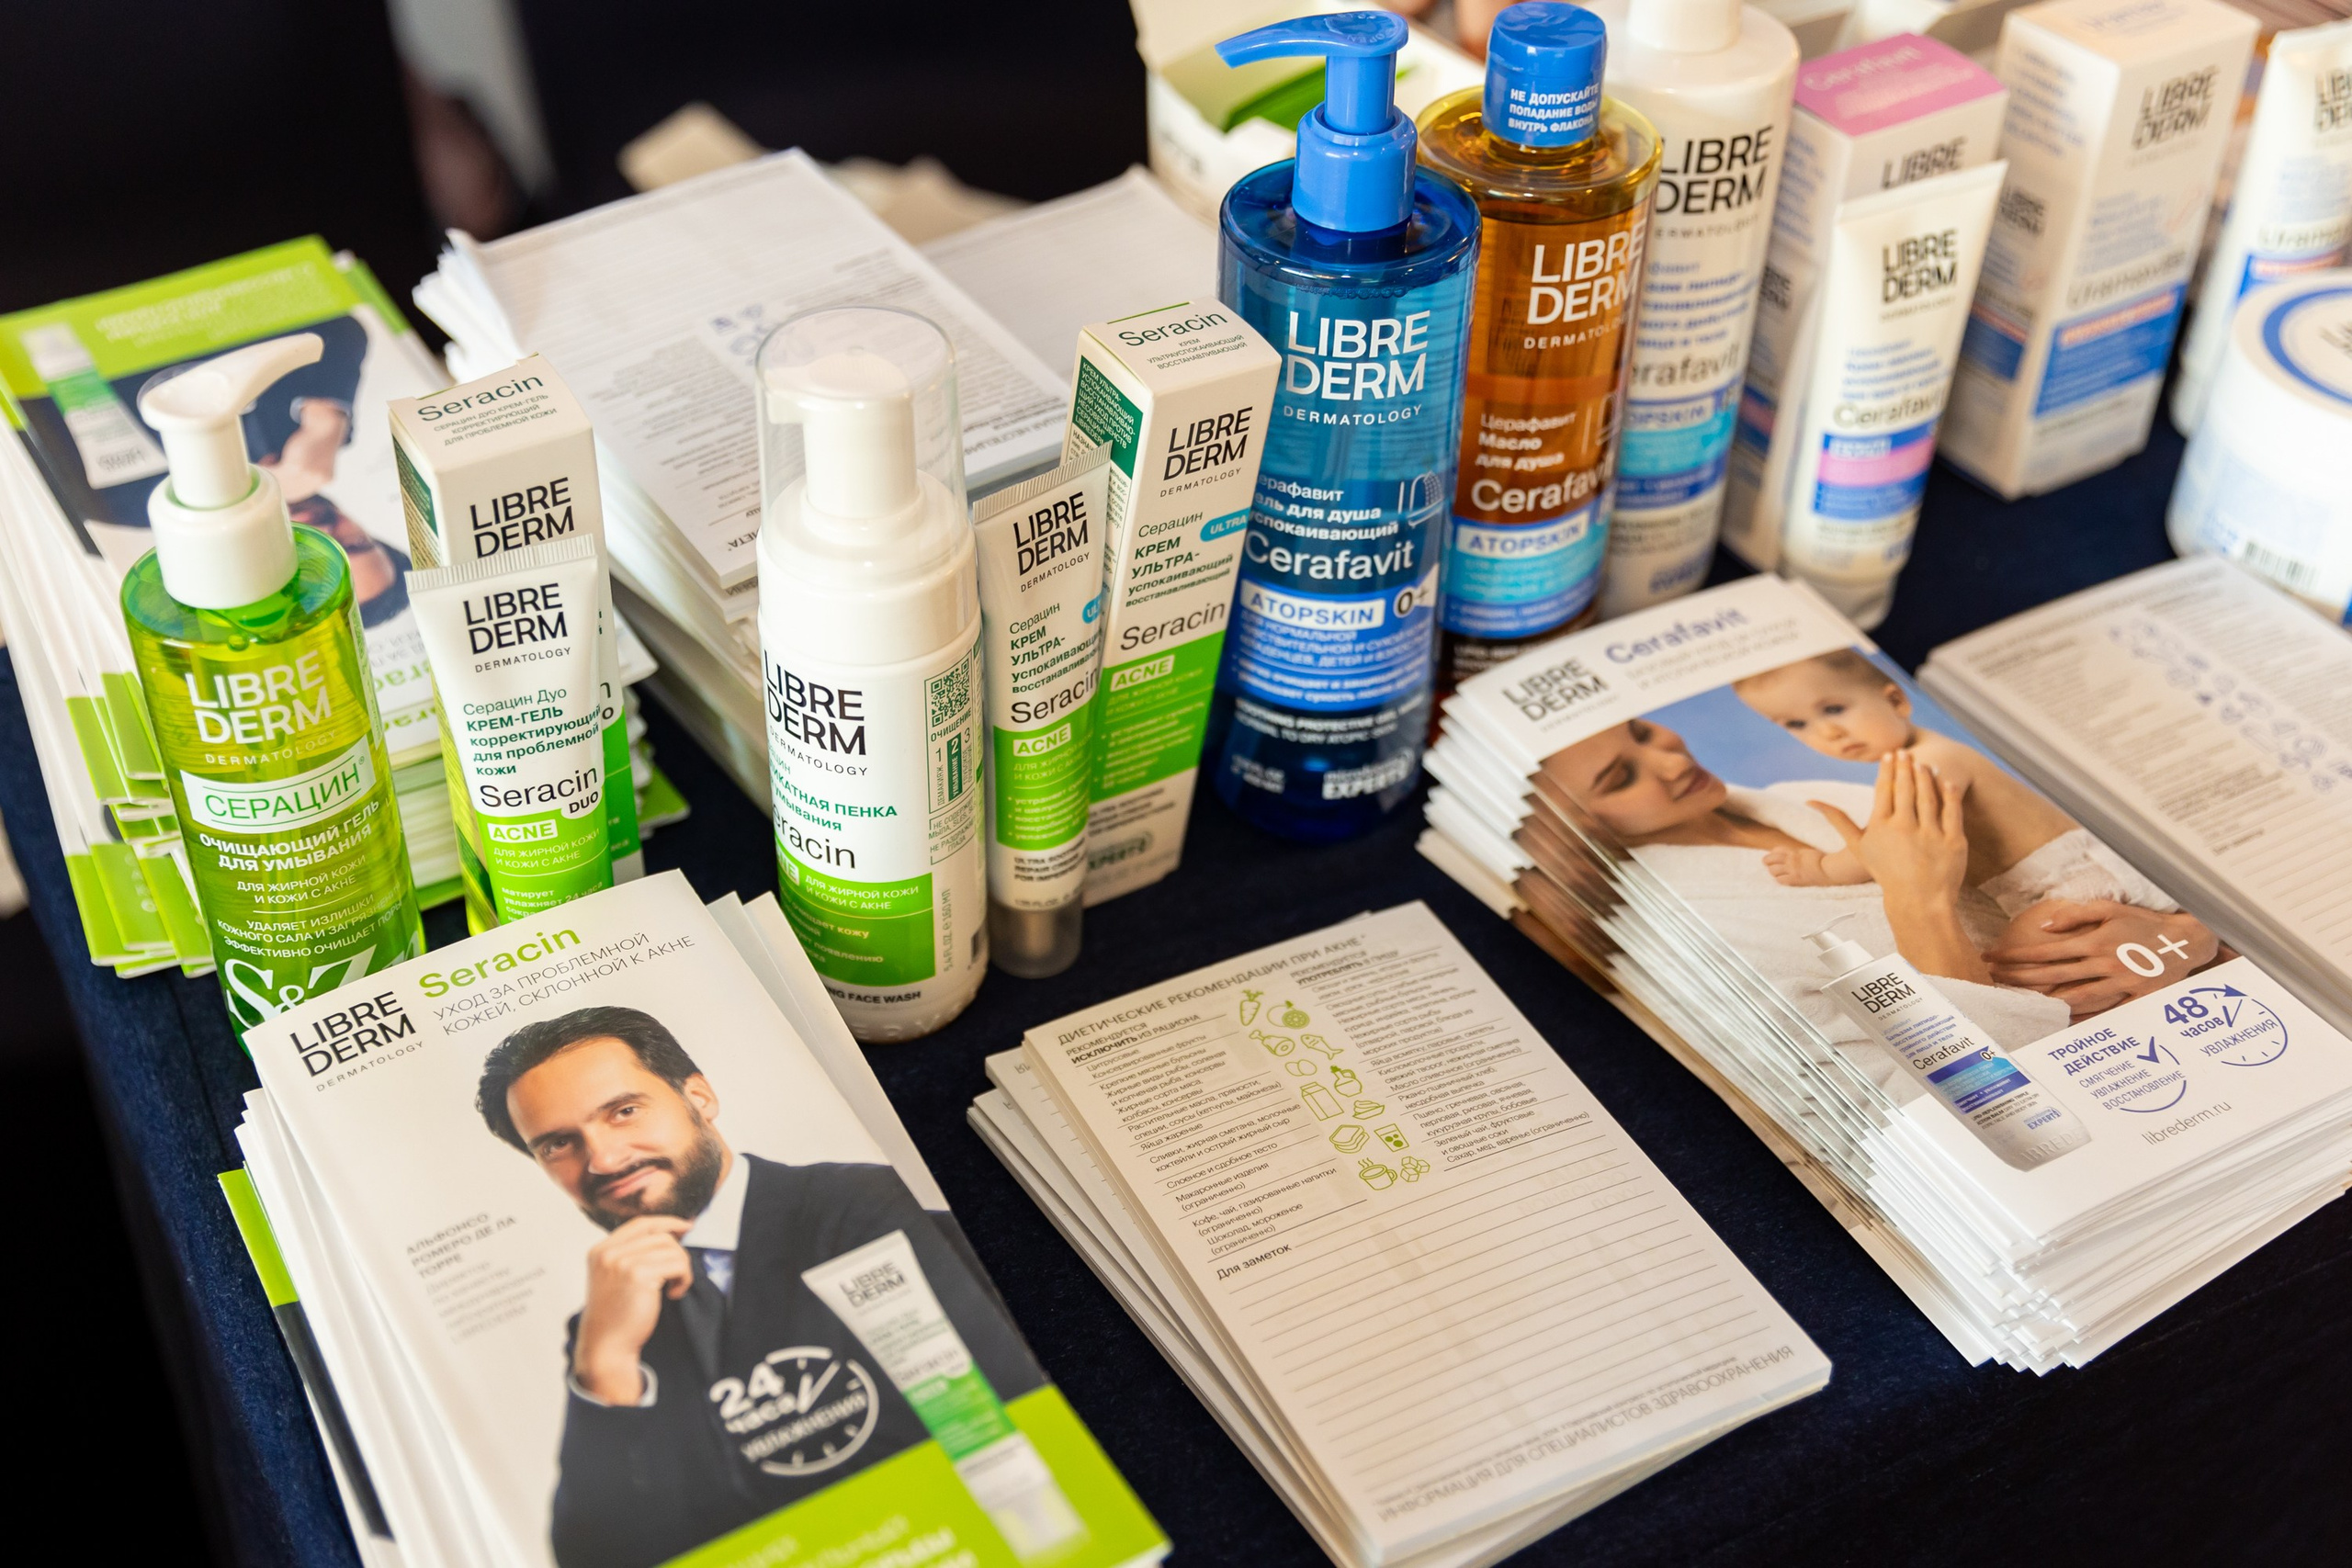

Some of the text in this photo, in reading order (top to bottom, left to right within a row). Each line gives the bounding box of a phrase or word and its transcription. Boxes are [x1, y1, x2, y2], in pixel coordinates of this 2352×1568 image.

[1509, 98, 1599, 119] ПОПАДАНИЕ ВОДЫ
[1510, 83, 1600, 107] НЕ ДОПУСКАЙТЕ
[2140, 66, 2219, 119] LIBRE
[1508, 115, 1594, 133] ВНУТРЬ ФЛАКОНА
[1656, 165, 1767, 214] DERM
[1532, 217, 1646, 284] LIBRE
[1883, 230, 1958, 271] LIBRE
[1526, 257, 1641, 325] DERM
[1883, 263, 1957, 303] DERM
[1118, 313, 1228, 346] Seracin
[1288, 310, 1430, 358] LIBRE
[1147, 334, 1245, 365] УЛЬТРАУСПОКАИВАЮЩИЙ
[1157, 342, 1248, 370] ВОССТАНАВЛИВАЮЩИЙ
[1286, 353, 1427, 400] DERM
[417, 375, 544, 423] Seracin
[1283, 404, 1422, 425] DERMATOLOGY
[450, 404, 541, 434] КОРРЕКТИРУЮЩИЙ
[464, 408, 558, 441] ПРОБЛЕМНОЙ КОЖИ
[1168, 406, 1253, 454] LIBRE
[1481, 412, 1577, 434] Церафавит
[1163, 434, 1248, 481] DERM
[1479, 433, 1542, 451] Масло
[1476, 452, 1565, 471] для душа
[1160, 467, 1242, 498] DERMATOLOGY
[1259, 474, 1344, 502] ерафавит
[469, 476, 571, 531] LIBRE
[1012, 491, 1087, 548] LIBRE
[1286, 504, 1382, 525] для душа
[474, 504, 575, 558] DERM
[1138, 512, 1203, 538] Серацин
[1209, 515, 1247, 535] ULTRA
[1469, 523, 1580, 552] ATOPSKIN
[1017, 519, 1089, 576] DERM
[1131, 550, 1200, 580] УЛЬТРА-
[1135, 536, 1181, 560] КРЕМ
[1246, 530, 1415, 581] Cerafavit
[1021, 552, 1091, 592] DERMATOLOGY
[1125, 568, 1231, 607] восстанавливающий
[1128, 553, 1233, 596] успокаивающий
[463, 582, 563, 626] LIBRE
[1010, 603, 1060, 635] Серацин
[1250, 592, 1374, 625] ATOPSKIN
[468, 611, 568, 655] DERM
[1011, 625, 1046, 650] КРЕМ
[1120, 601, 1226, 651] Seracin
[1604, 606, 1747, 663] Cerafavit
[474, 647, 571, 673] DERMATOLOGY
[1011, 636, 1066, 666] УЛЬТРА-
[185, 650, 324, 708] LIBRE
[763, 649, 865, 722] LIBRE
[1114, 659, 1171, 689] ACNE
[1502, 656, 1585, 705] LIBRE
[463, 687, 568, 716] Серацин Дуо
[1011, 668, 1097, 724] Seracin
[1520, 676, 1609, 722] DERM
[194, 686, 332, 744] DERM
[467, 705, 564, 732] КРЕМ-ГЕЛЬ
[470, 703, 602, 749] корректирующий
[767, 689, 866, 756] DERM
[931, 707, 972, 741] ОЧИЩЕНИЕ
[205, 729, 337, 765] DERMATOLOGY
[506, 722, 600, 761] проблемной
[769, 725, 868, 777] DERMATOLOGY
[1016, 726, 1069, 754] ACNE
[476, 764, 517, 776] кожи
[480, 767, 598, 807] Seracin
[569, 790, 600, 815] DUO
[775, 784, 842, 831] умывания
[834, 803, 898, 818] ПЕНКА
[199, 800, 379, 857] ОЧИЩАЮЩИЙ ГЕЛЬ
[493, 821, 554, 841] ACNE
[493, 828, 601, 858] ДЛЯ ЖИРНОЙ КОЖИ
[773, 802, 856, 869] eracin
[218, 824, 372, 872] ДЛЯ УМЫВАНИЯ
[237, 854, 367, 893] ДЛЯ ЖИРНОЙ КОЖИ
[266, 874, 356, 904] КОЖИ АКНЕ
[828, 883, 919, 899] ЖИРНОЙ КОЖИ
[217, 919, 313, 943] КОЖНОГО САЛА
[246, 894, 375, 932] УДАЛЯЕТ ИЗЛИШКИ
[223, 926, 377, 958] ЭФФЕКТИВНО ОЧИЩАЕТ
[2116, 934, 2189, 977] 0+
[419, 928, 581, 998] Seracin
[434, 932, 650, 1021] УХОД ЗА ПРОБЛЕМНОЙ
[443, 935, 695, 1036] КОЖЕЙ, СКЛОННОЙ К АКНЕ
[847, 991, 922, 1004] FACE WASH
[1058, 1000, 1167, 1046] ДИЕТИЧЕСКИЕ
[1168, 959, 1288, 1006] РЕКОМЕНДАЦИИ
[1290, 950, 1320, 965] ПРИ
[1324, 937, 1362, 955] АКНЕ
[1851, 973, 1904, 1002] LIBRE
[1863, 984, 1916, 1014] DERM
[290, 991, 402, 1054] LIBRE
[1878, 997, 1924, 1021] DERMATOLOGY
[2165, 996, 2209, 1025] 48
[301, 1013, 415, 1077] DERM
[1071, 1014, 1201, 1065] ИСКЛЮЧИТЬ РАЦИОНА
[2048, 1028, 2117, 1061] ТРОЙНОЕ
[2180, 1016, 2225, 1040] часов
[2199, 1019, 2278, 1056] УВЛАЖНЕНИЯ
[316, 1041, 424, 1092] DERMATOLOGY
[1913, 1036, 1975, 1070] Cerafavit
[2064, 1036, 2141, 1076] ДЕЙСТВИЕ
[1236, 1080, 1283, 1103] майонезы)
[2079, 1061, 2134, 1089] СМЯГЧЕНИЕ
[2090, 1069, 2151, 1100] УВЛАЖНЕНИЕ
[2103, 1070, 2186, 1111] ВОССТАНОВЛЕНИЕ
[1127, 1105, 1187, 1133] Растительные
[1257, 1102, 1302, 1124] молочные
[1491, 1109, 1535, 1130] фруктовые
[1530, 1111, 1589, 1137] (ограниченно)
[2142, 1101, 2233, 1145] librederm.ru
[1156, 1123, 1272, 1173] коктейли острый жирный
[1164, 1122, 1204, 1142] жареные
[1166, 1152, 1252, 1190] Слоеное сдобное
[1175, 1161, 1270, 1203] Макаронные изделия
[1238, 1167, 1337, 1208] газированные напитки
[1181, 1181, 1247, 1213] (ограниченно)
[407, 1213, 489, 1255] АЛЬФОНСО
[1207, 1201, 1304, 1247] Шоколад, мороженое
[840, 1262, 897, 1296] LIBRE
[1216, 1243, 1293, 1280] Для заметок
[847, 1273, 906, 1308] DERM
[709, 1362, 785, 1419] 24
[1376, 1345, 1795, 1523] ИНФОРМАЦИЯ ДЛЯ СПЕЦИАЛИСТОВ ЗДРАВООХРАНЕНИЯ
